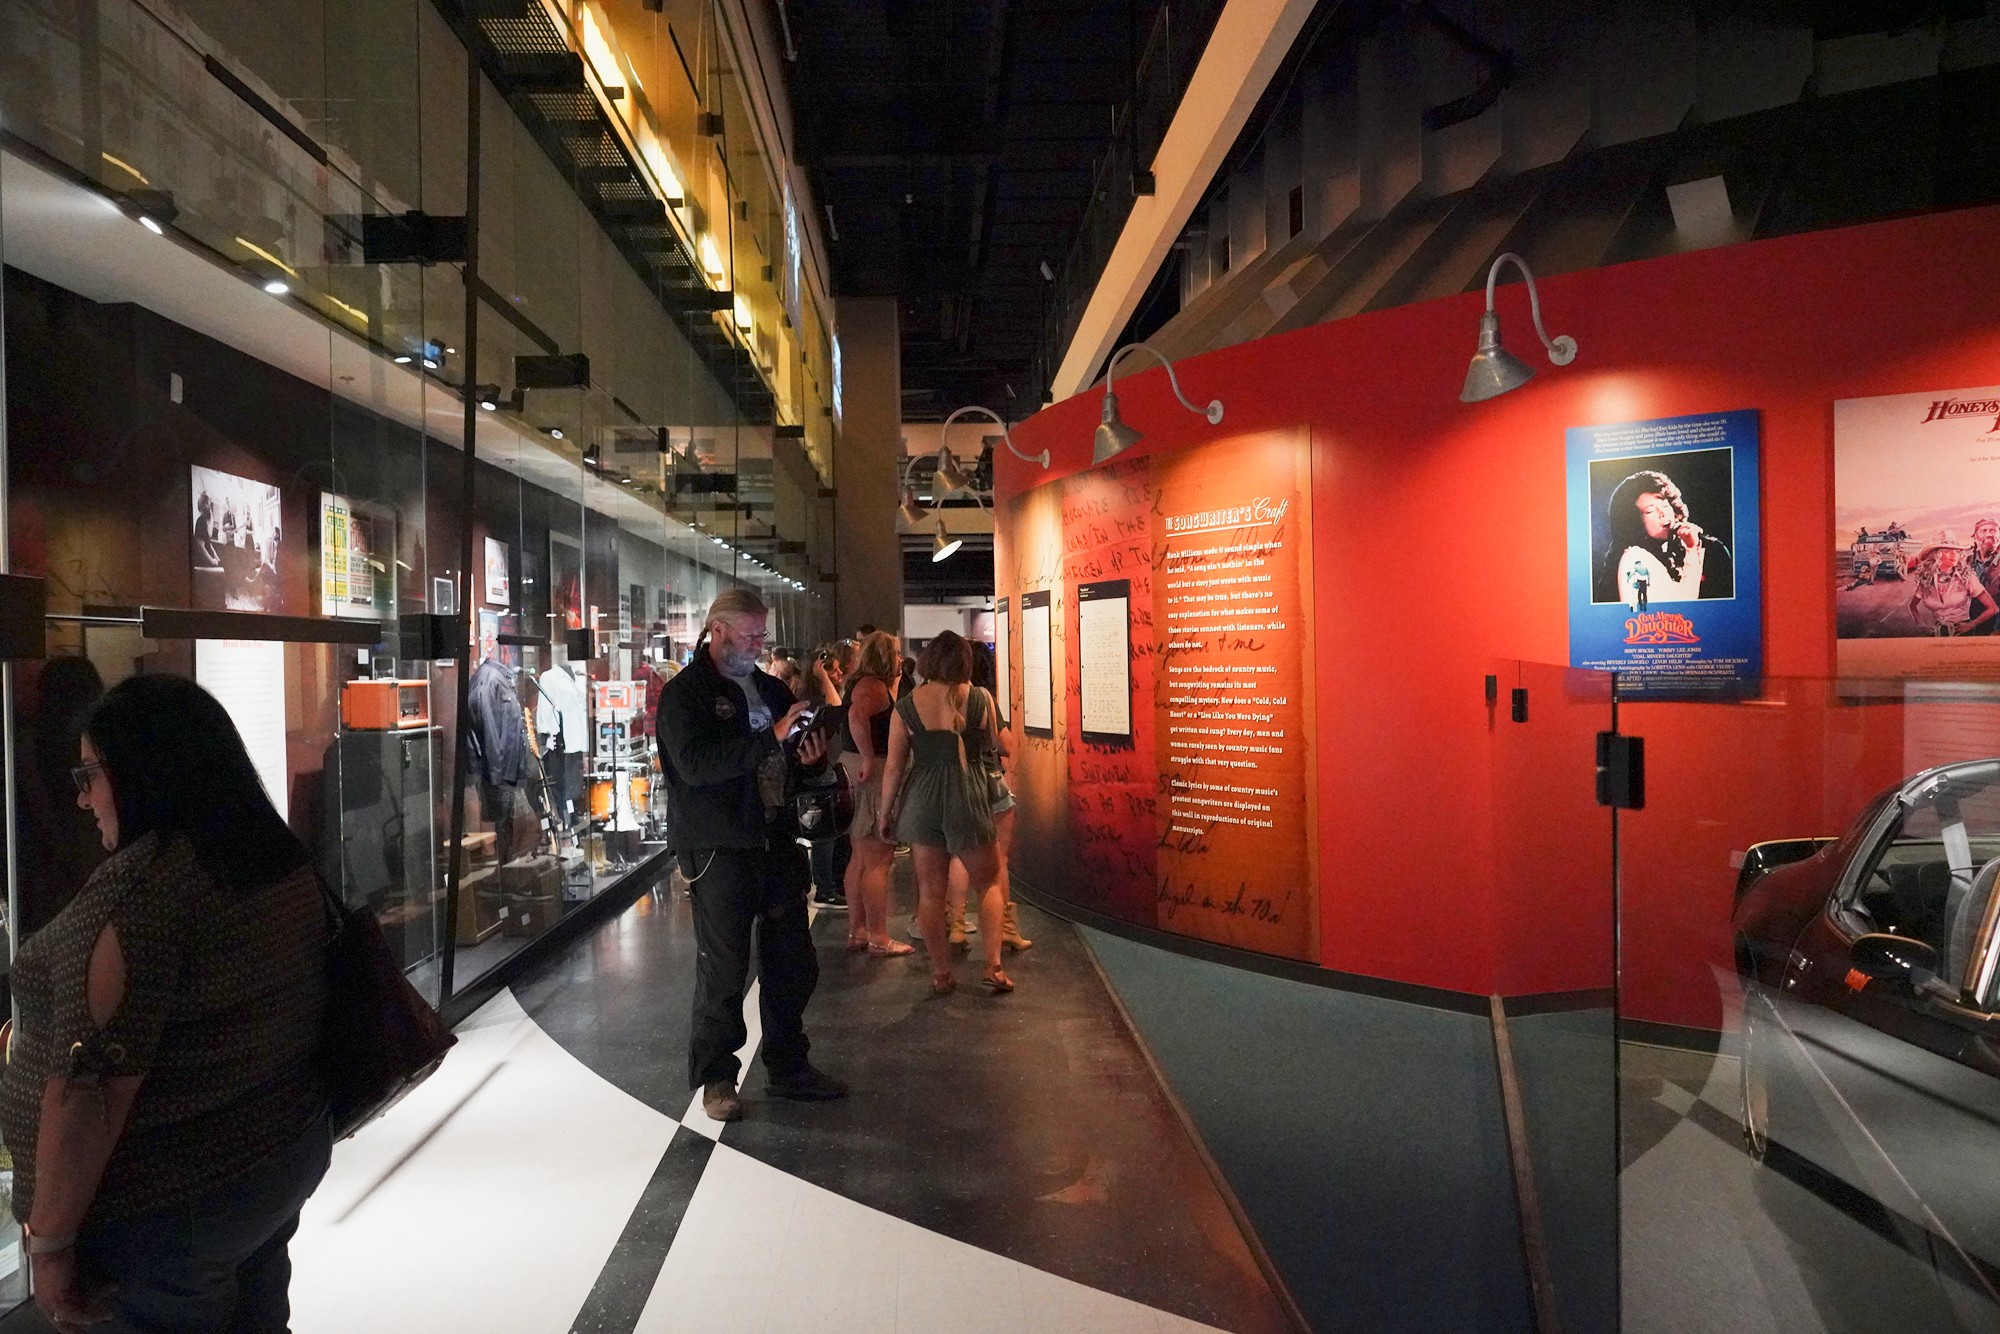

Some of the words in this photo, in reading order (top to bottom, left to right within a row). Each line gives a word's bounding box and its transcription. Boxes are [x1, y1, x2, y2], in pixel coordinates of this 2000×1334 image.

[1166, 517, 1174, 530] THE
[1174, 506, 1251, 531] SONGWRITER'S
[1253, 497, 1289, 526] Craft
[1114, 516, 1145, 538] THE
[1167, 551, 1180, 559] Hank
[1181, 549, 1203, 558] Williams
[1219, 546, 1224, 554] it
[1224, 545, 1242, 554] sound
[1244, 543, 1263, 553] simple
[1175, 565, 1186, 574] said,
[1194, 565, 1207, 573] song
[1208, 563, 1221, 571] ain't
[1222, 560, 1245, 569] nothin'
[1246, 559, 1252, 567] in
[1254, 558, 1265, 567] the
[1167, 581, 1181, 589] world
[1196, 580, 1209, 588] story
[1209, 578, 1221, 588] just
[1221, 577, 1236, 585] wrote
[1238, 575, 1252, 584] with
[1253, 574, 1271, 583] music
[1183, 595, 1196, 603] That
[1196, 596, 1207, 604] may
[1231, 592, 1241, 600] but
[1242, 591, 1264, 599] there's
[1179, 610, 1211, 620] explanation
[1211, 609, 1220, 617] for
[1220, 608, 1235, 616] what
[1236, 607, 1254, 615] makes
[1272, 605, 1279, 614] of
[1168, 626, 1182, 634] those
[1182, 625, 1200, 633] stories
[1222, 623, 1236, 632] with
[1237, 623, 1266, 631] listeners,
[1267, 622, 1286, 630] while
[1168, 641, 1184, 649] others
[1193, 665, 1202, 673] the
[1203, 665, 1224, 673] bedrock
[1225, 665, 1231, 673] of
[1232, 666, 1256, 674] country
[1256, 665, 1277, 674] music,
[1179, 681, 1210, 690] songwriting
[1210, 681, 1233, 689] remains
[1170, 696, 1198, 706] compelling
[1198, 697, 1220, 706] mystery.
[1234, 696, 1247, 704] does
[1253, 697, 1272, 706] "Cold,
[1273, 697, 1287, 705] Cold
[1198, 711, 1212, 719] "Live
[1212, 712, 1224, 720] Like
[1252, 713, 1274, 723] Dying"
[1180, 726, 1198, 734] written
[1210, 728, 1227, 737] sung?
[1227, 728, 1243, 738] Every
[1244, 728, 1256, 738] day,
[1272, 730, 1284, 738] and
[1189, 742, 1204, 751] rarely
[1218, 743, 1225, 752] by
[1226, 745, 1248, 754] country
[1250, 745, 1268, 753] music
[1269, 745, 1283, 754] fans
[1170, 756, 1192, 765] struggle
[1192, 757, 1204, 765] with
[1205, 757, 1217, 766] that
[1217, 760, 1230, 768] very
[1230, 760, 1258, 769] question.
[1171, 779, 1188, 788] Classic
[1189, 781, 1202, 790] lyrics
[1203, 782, 1210, 792] by
[1224, 784, 1231, 792] of
[1231, 787, 1254, 796] country
[1255, 788, 1278, 796] music's
[1192, 798, 1223, 807] songwriters
[1234, 801, 1261, 812] displayed
[1172, 809, 1182, 817] this
[1182, 811, 1194, 819] wall
[1201, 814, 1240, 824] reproductions
[1240, 817, 1246, 825] of
[1247, 819, 1273, 828] original
[1172, 826, 1204, 836] manuscripts.
